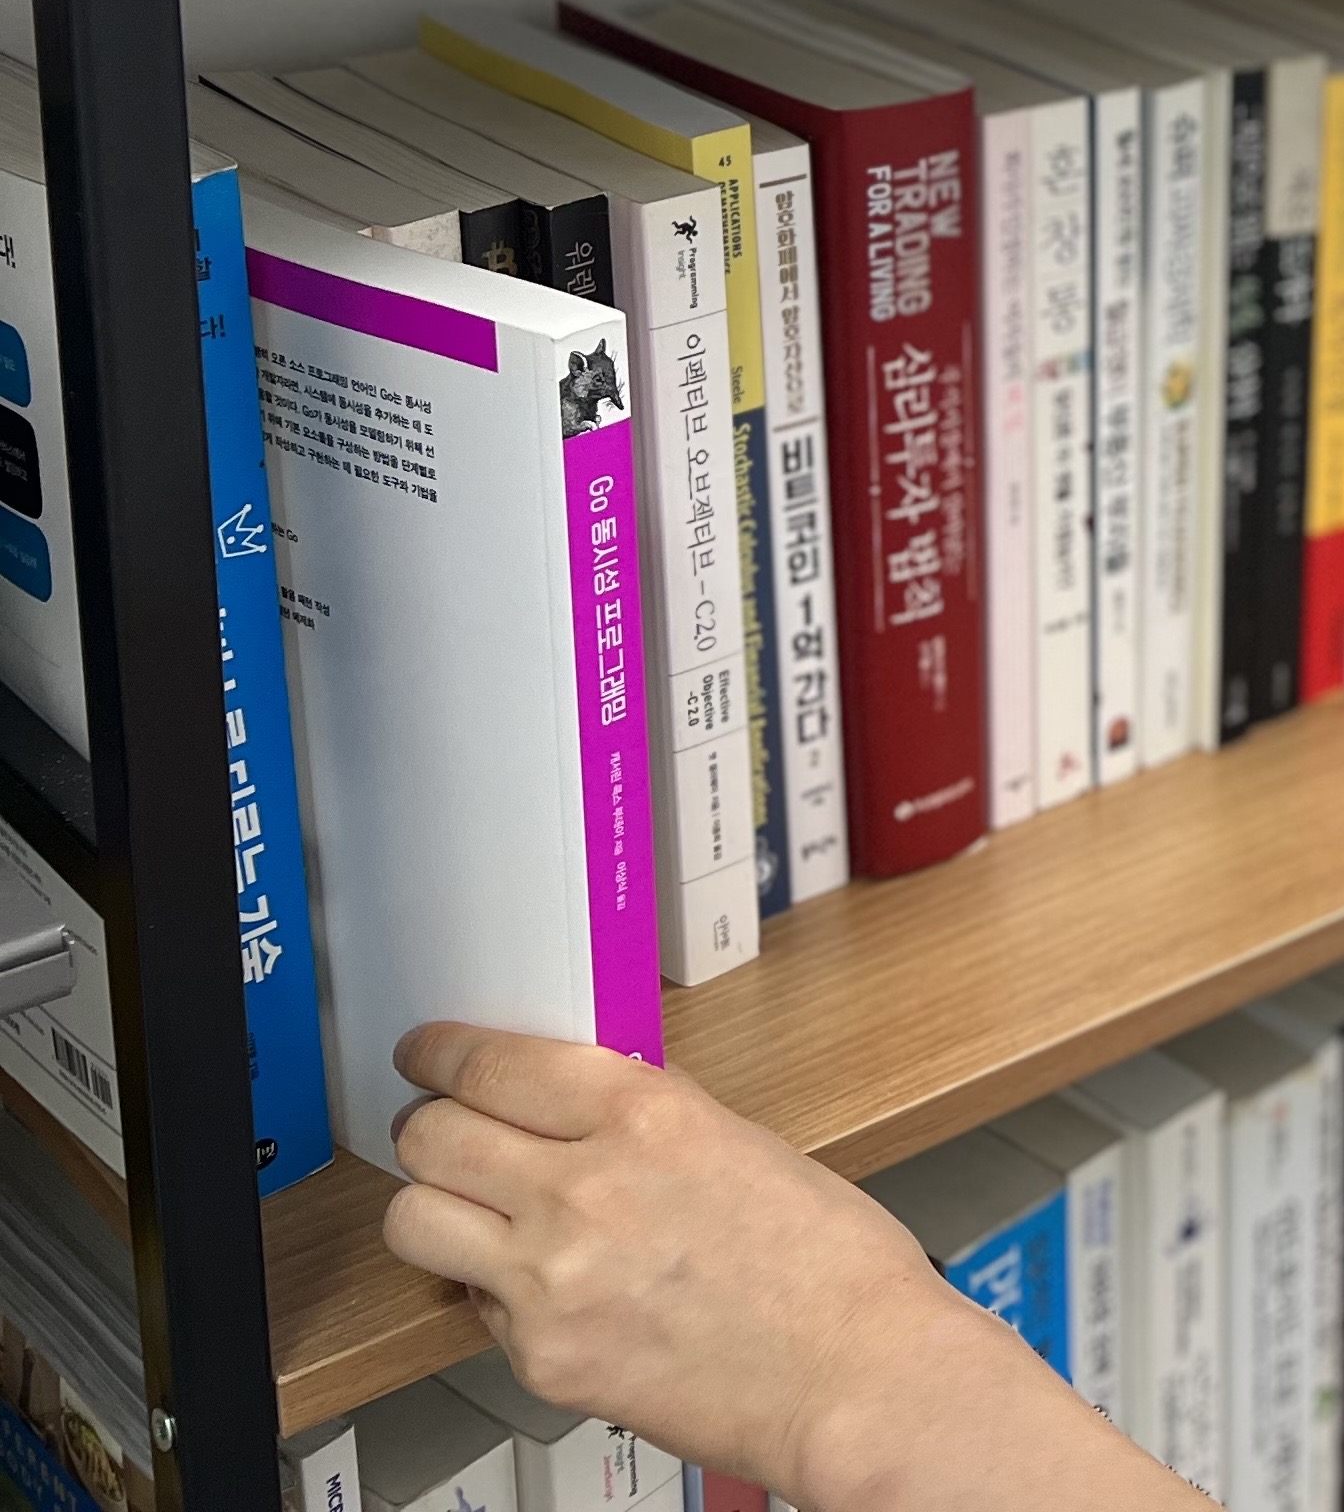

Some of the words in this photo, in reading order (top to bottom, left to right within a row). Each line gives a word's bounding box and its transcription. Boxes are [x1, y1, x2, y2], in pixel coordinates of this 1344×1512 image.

[718, 155, 733, 167] 45
[867, 164, 893, 217] FOR
[928, 149, 962, 239] NEW
[728, 178, 743, 260] APPLICATIONS
[774, 190, 800, 305] 암호화폐에서
[868, 222, 894, 239] A
[894, 158, 932, 317] TRADING
[687, 246, 700, 310] Programming
[868, 239, 897, 323] LIVING
[270, 352, 286, 367] 오픈
[288, 358, 304, 373] 소스
[307, 365, 348, 388] 프로그래밍
[351, 379, 377, 397] 언어인
[379, 388, 402, 405] Go는
[405, 394, 431, 414] 동시성
[302, 404, 322, 422] Go가
[678, 332, 709, 442] 이펙티브
[732, 365, 744, 405] Steele
[336, 437, 370, 459] 구성하는
[374, 407, 410, 430] 추가하는
[882, 343, 941, 525] 심리투자
[307, 447, 340, 470] 구현하는
[353, 464, 379, 484] 필요한
[382, 473, 408, 493] 도구와
[589, 474, 615, 513] Go
[287, 528, 298, 543] Go
[686, 446, 716, 578] 오브젝티브
[782, 434, 821, 588] 비트코인
[591, 516, 621, 596] 동시성
[886, 528, 945, 628] 법칙
[793, 592, 825, 663] 1억
[596, 597, 628, 728] 프로그래밍
[718, 668, 731, 724] Effective
[688, 706, 701, 728] 2.0
[703, 673, 717, 731] Objective
[795, 668, 829, 745] 간다
[239, 891, 283, 985] 기술
